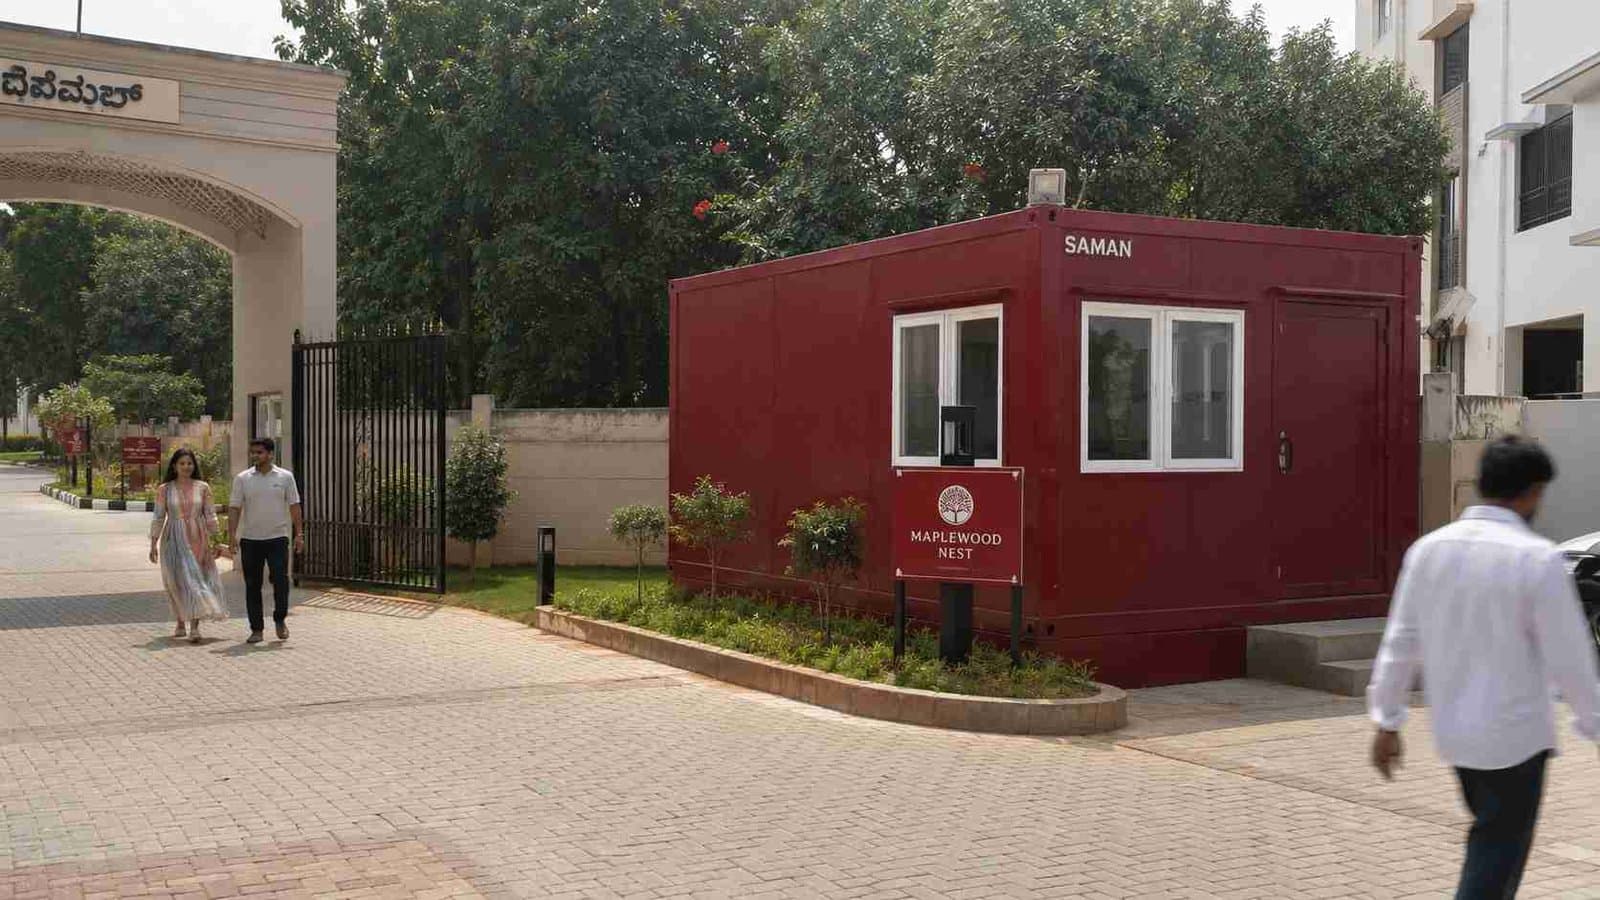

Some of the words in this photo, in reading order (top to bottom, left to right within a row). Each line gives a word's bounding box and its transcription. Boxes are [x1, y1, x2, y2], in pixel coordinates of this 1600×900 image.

[1064, 235, 1132, 258] SAMAN
[911, 530, 1002, 545] MAPLEWOOD
[939, 547, 973, 560] NEST
